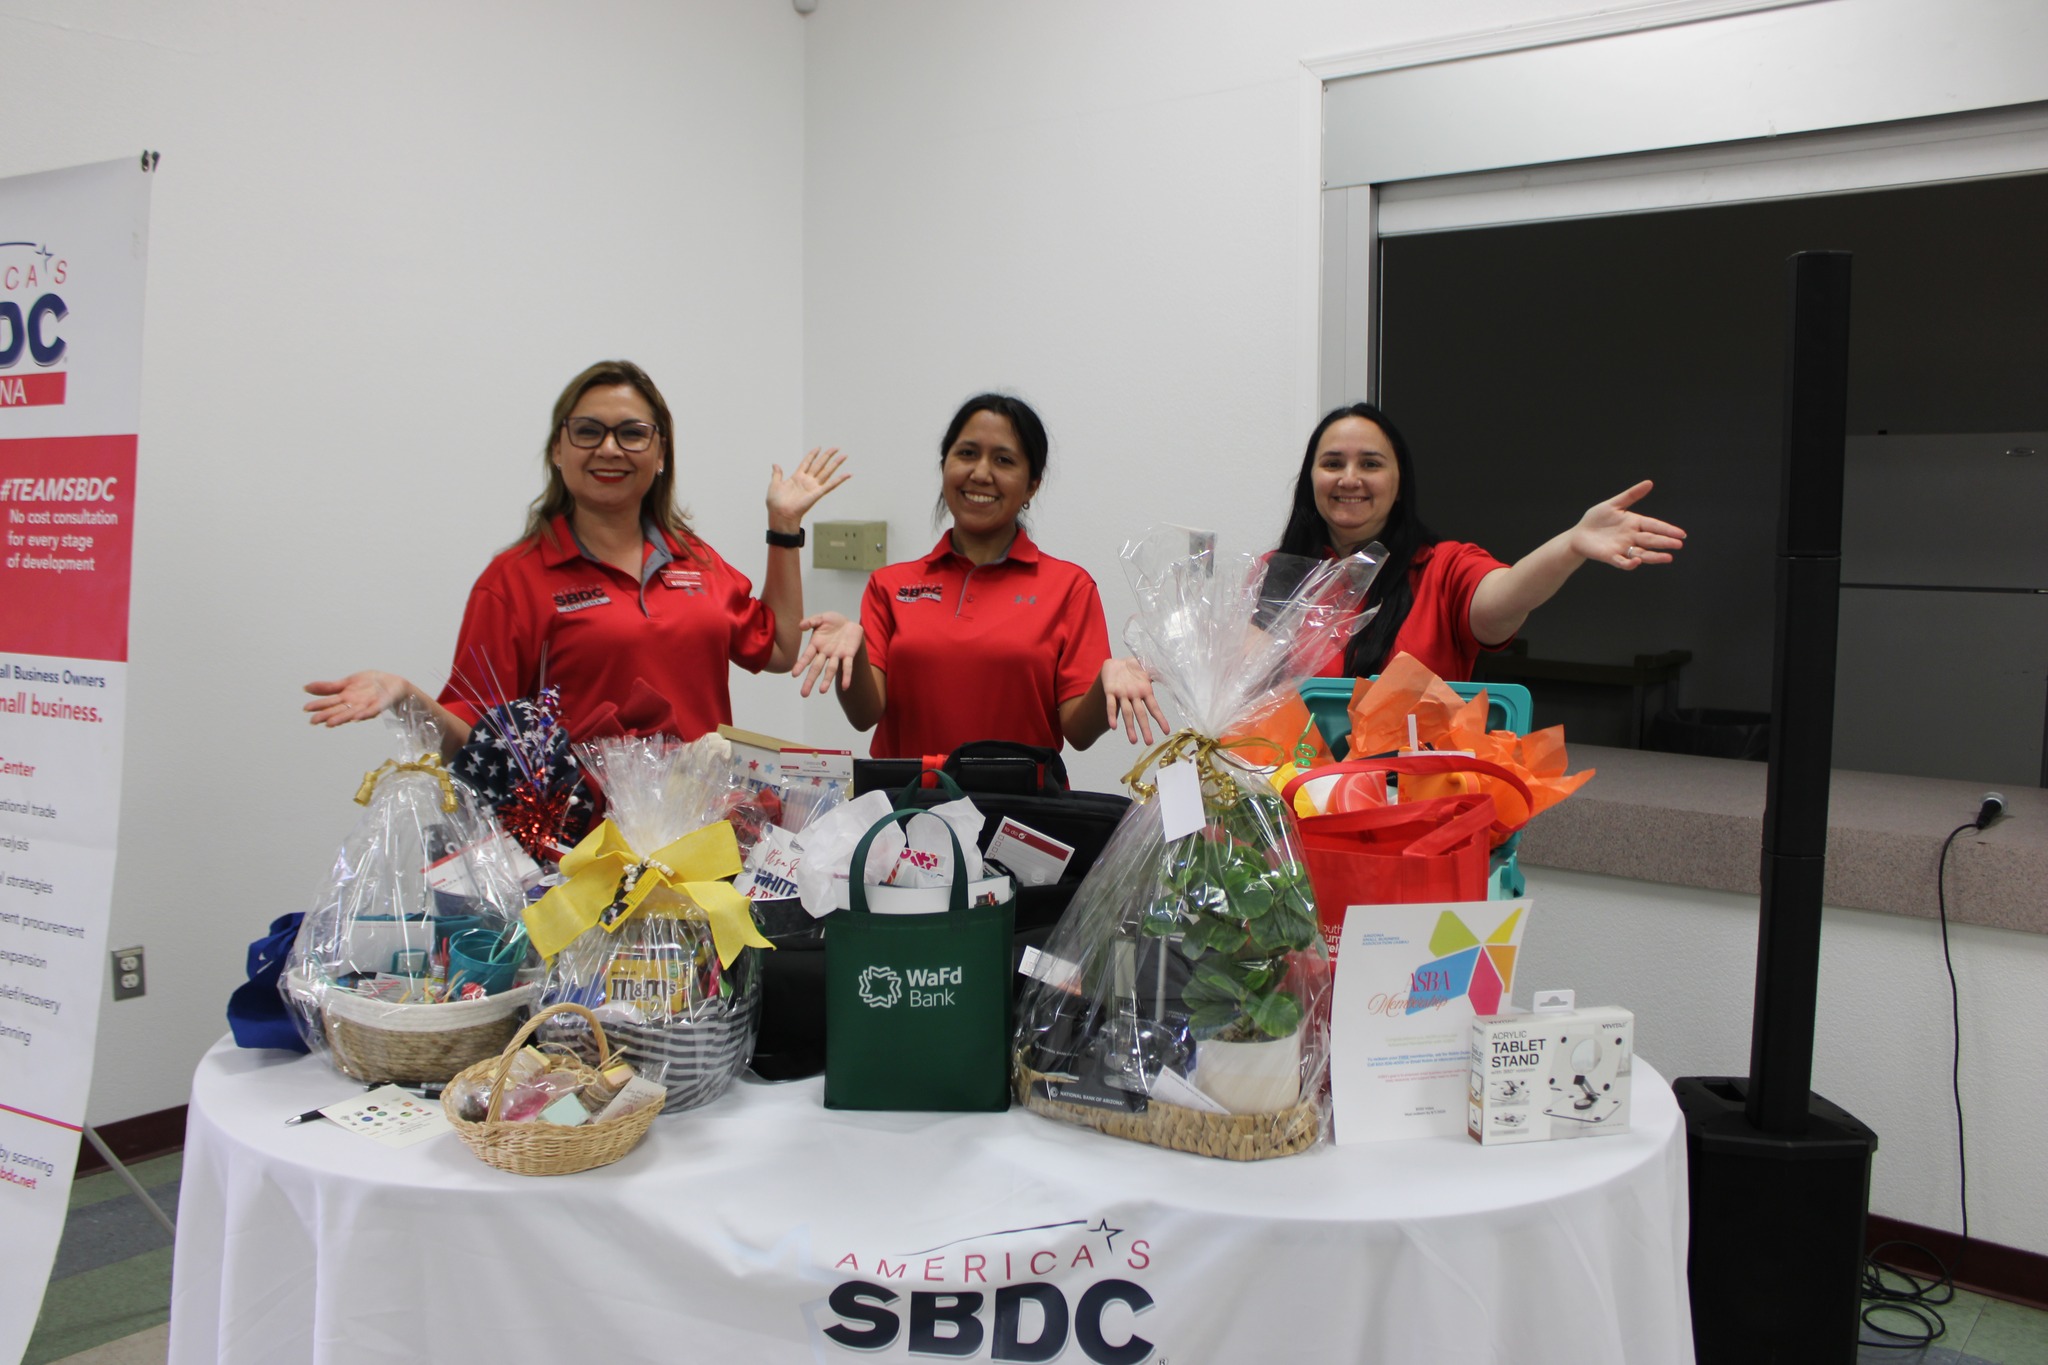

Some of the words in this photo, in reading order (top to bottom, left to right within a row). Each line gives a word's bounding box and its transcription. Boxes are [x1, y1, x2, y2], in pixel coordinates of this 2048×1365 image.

[0, 477, 117, 502] #TEAMSBDC
[9, 508, 25, 524] No
[28, 511, 51, 524] cost
[53, 508, 118, 525] consultation
[8, 530, 25, 546] for
[28, 536, 59, 551] every
[61, 534, 94, 552] stage
[7, 552, 20, 568] of
[22, 553, 95, 574] development
[553, 588, 605, 606] SBDC
[898, 586, 942, 597] SBDC
[14, 665, 59, 683] Business
[63, 669, 105, 688] Owners
[31, 693, 103, 723] business.
[31, 803, 56, 819] trade
[6, 875, 53, 895] strategies
[22, 917, 85, 939] procurement
[906, 966, 962, 987] WaFd
[1403, 970, 1451, 992] ASBA
[910, 988, 955, 1007] Bank
[1492, 1030, 1527, 1040] ACRYLIC
[1492, 1039, 1547, 1054] TABLET
[1492, 1053, 1539, 1068] STAND
[1060, 1091, 1082, 1099] NATIONAL
[1102, 1097, 1124, 1106] ARIZONA
[12, 1152, 54, 1177] scanning
[834, 1239, 1151, 1284] AMERICA'S
[823, 1278, 1157, 1365] SBDC
